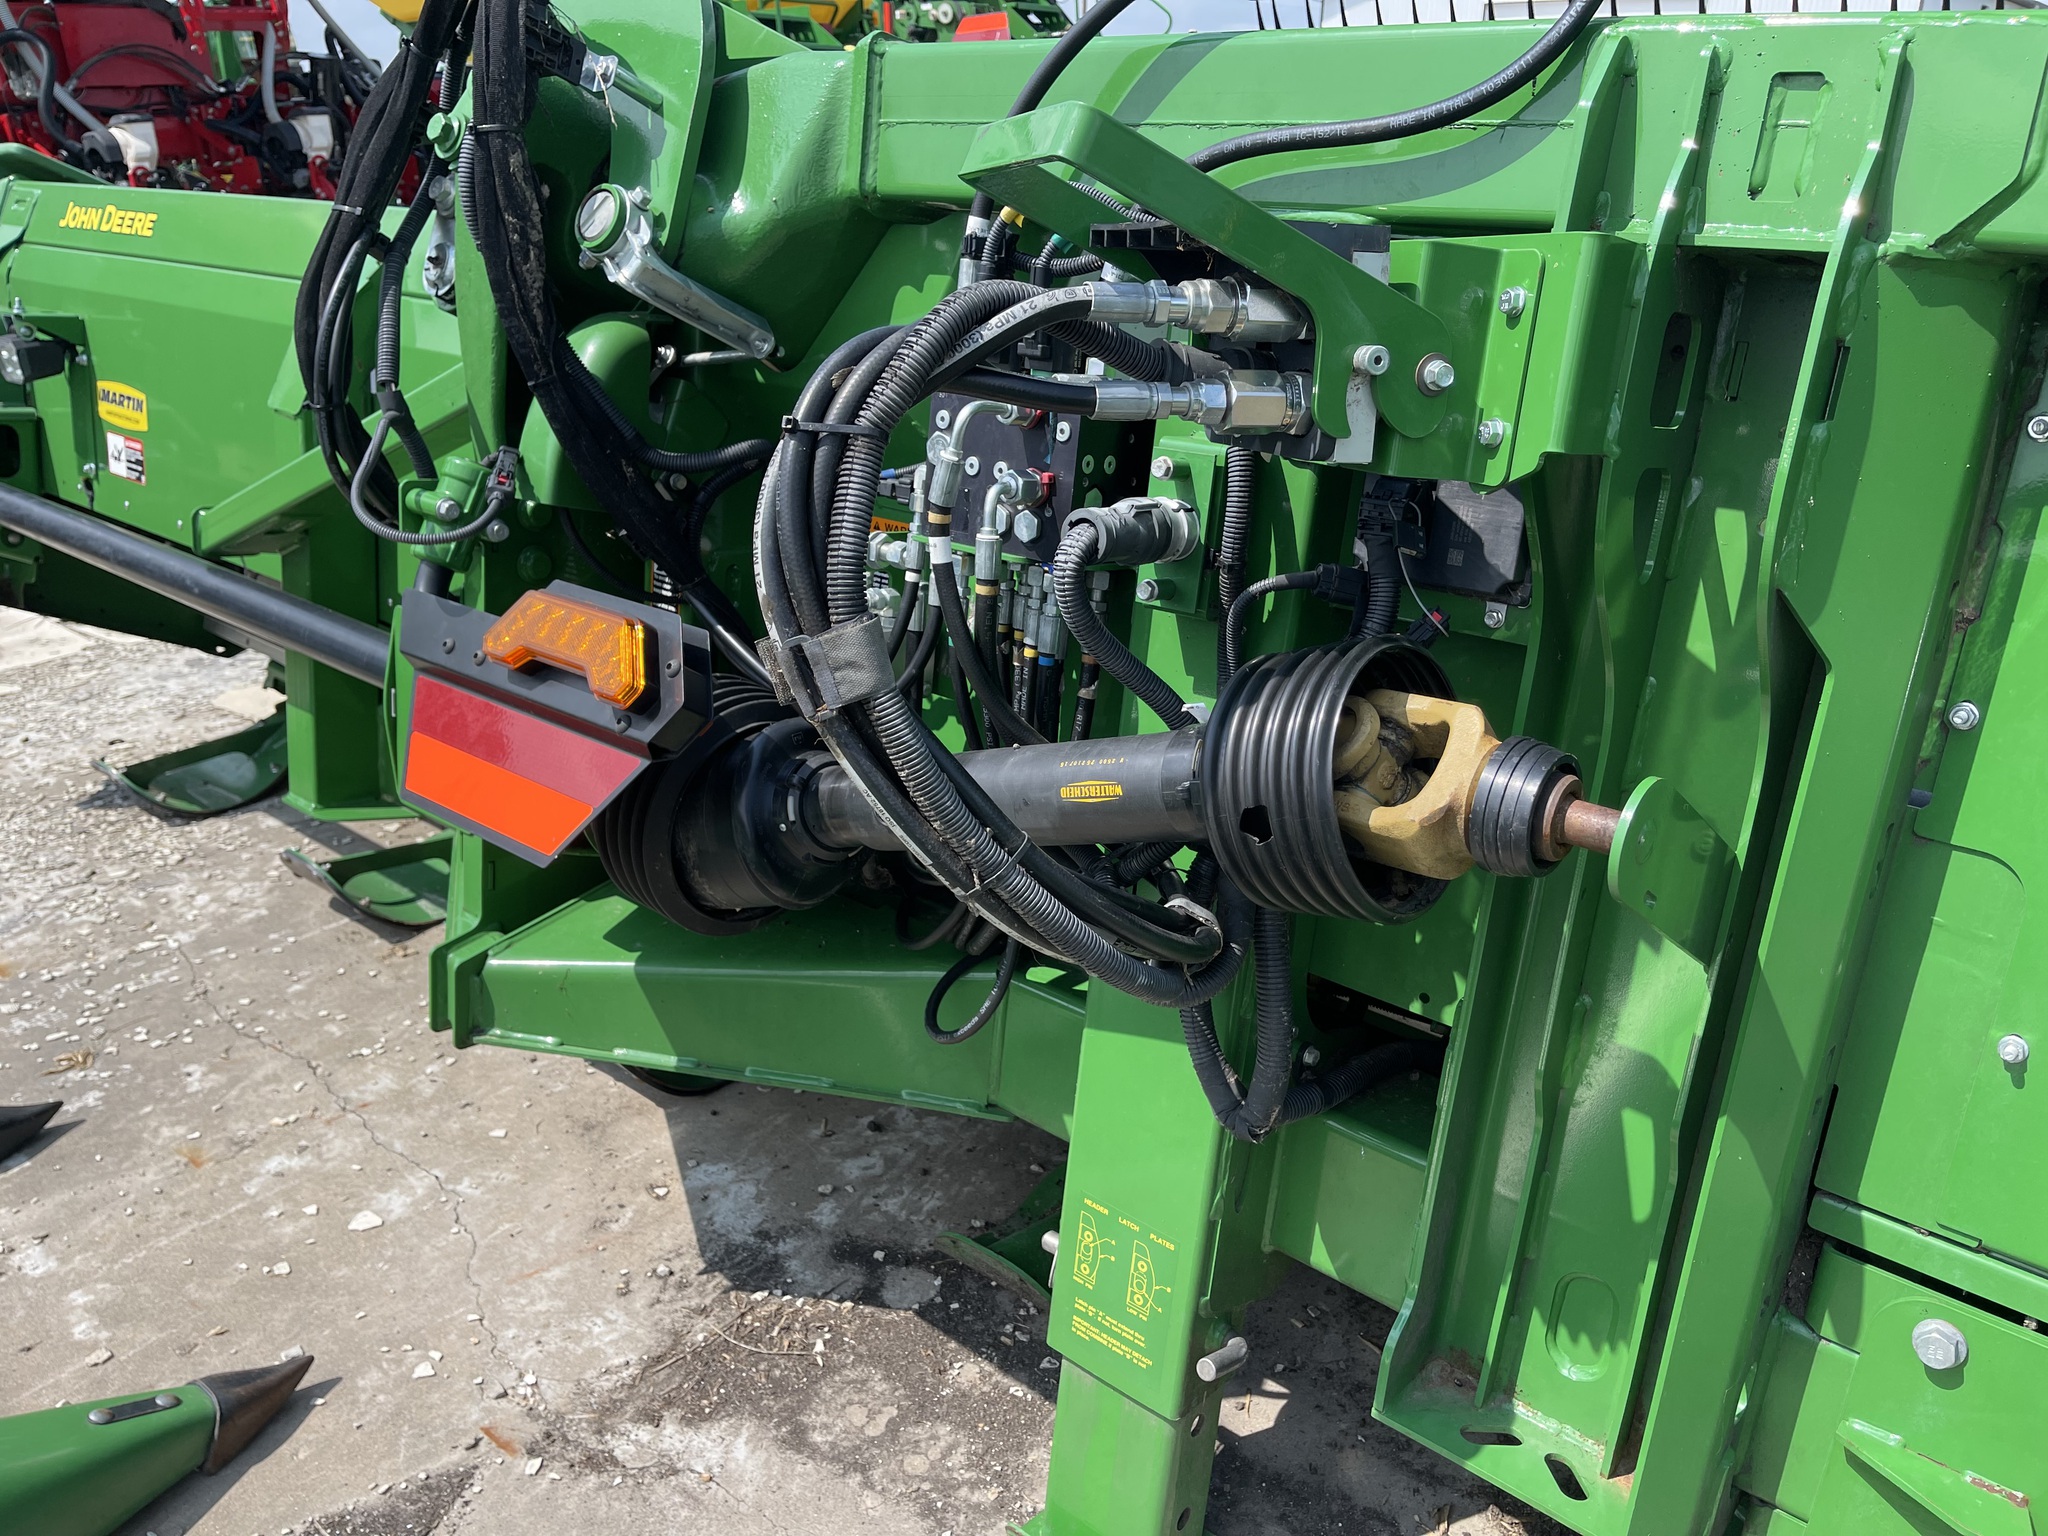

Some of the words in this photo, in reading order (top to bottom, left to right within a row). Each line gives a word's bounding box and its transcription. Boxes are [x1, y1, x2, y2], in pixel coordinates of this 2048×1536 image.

[1389, 114, 1416, 130] MADE
[1422, 110, 1436, 121] IN
[1442, 92, 1476, 115] ITALY
[1266, 133, 1290, 145] MSHA
[58, 201, 104, 231] JOHN
[99, 203, 159, 238] DEERE
[99, 388, 144, 413] MARTIN
[884, 522, 910, 533] WAR
[1020, 686, 1028, 711] MADE
[1060, 784, 1123, 799] WALTERSCHEID
[1083, 1197, 1110, 1216] HEADER
[1118, 1216, 1140, 1233] LATCH
[1149, 1232, 1176, 1252] PLATES
[1100, 1331, 1121, 1348] HEADER
[1131, 1349, 1153, 1367] DETACH
